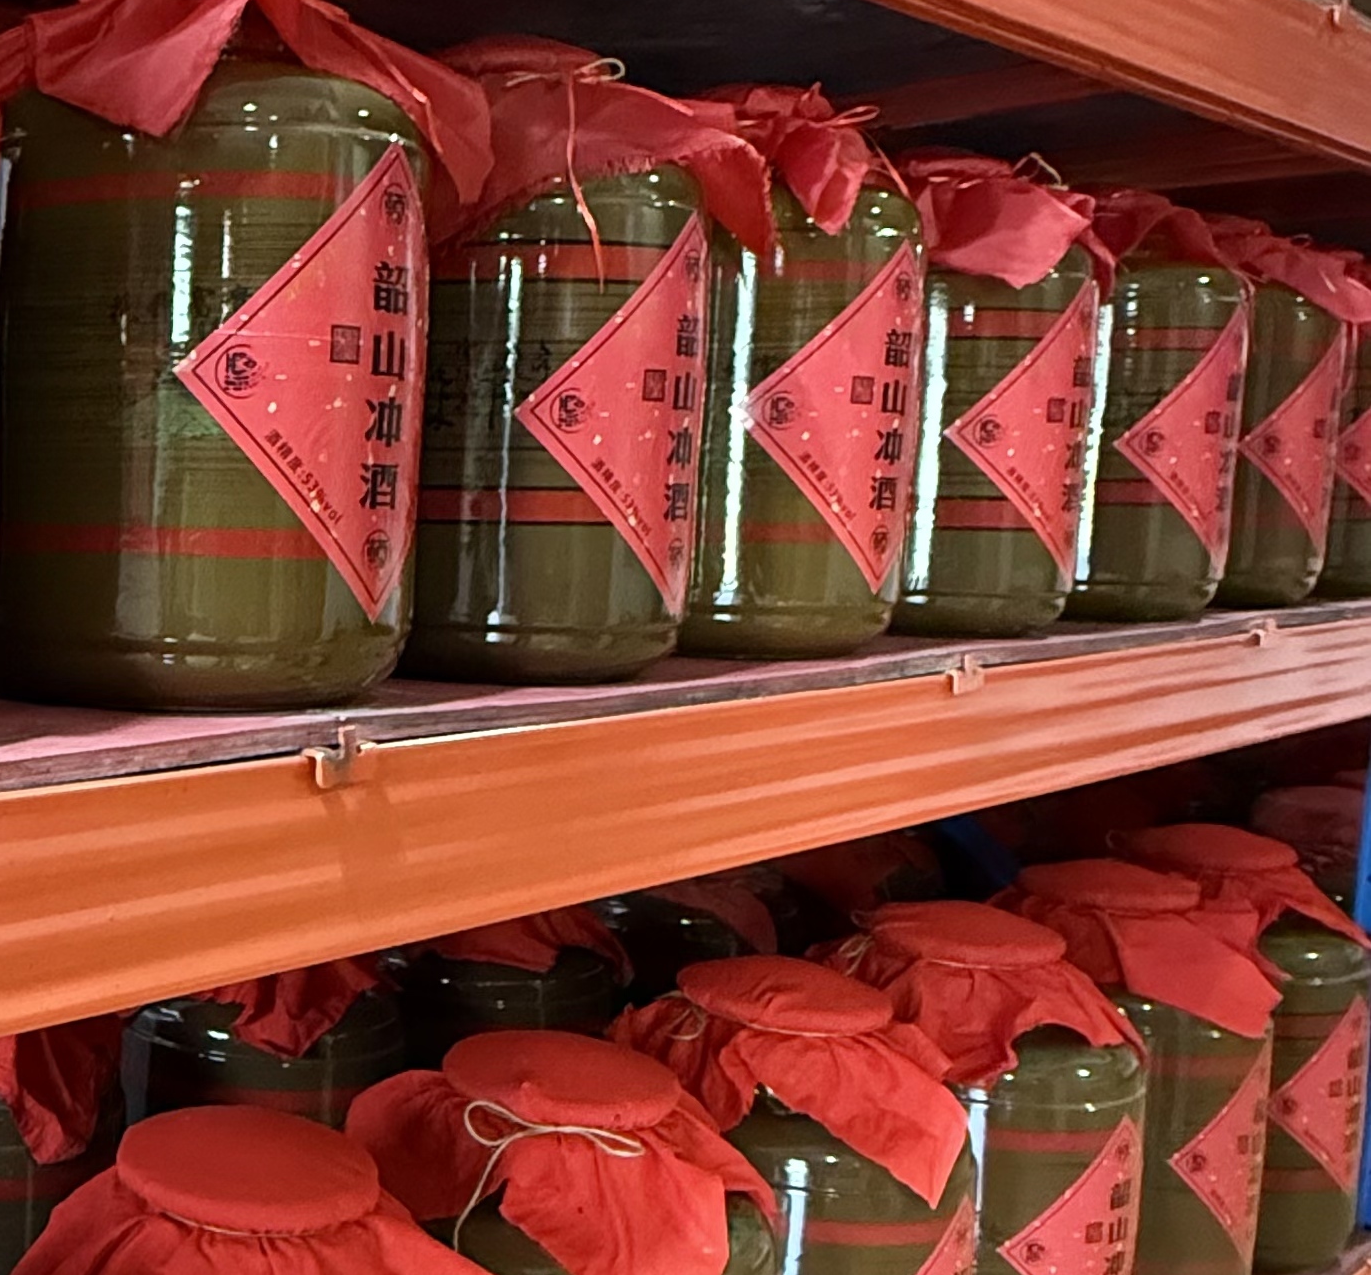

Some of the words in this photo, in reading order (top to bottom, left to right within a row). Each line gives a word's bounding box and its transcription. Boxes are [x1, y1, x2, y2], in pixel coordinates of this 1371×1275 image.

[358, 262, 410, 510] 韶山冲酒
[663, 314, 699, 522] 韶山冲酒
[868, 329, 912, 512] 韶山冲酒
